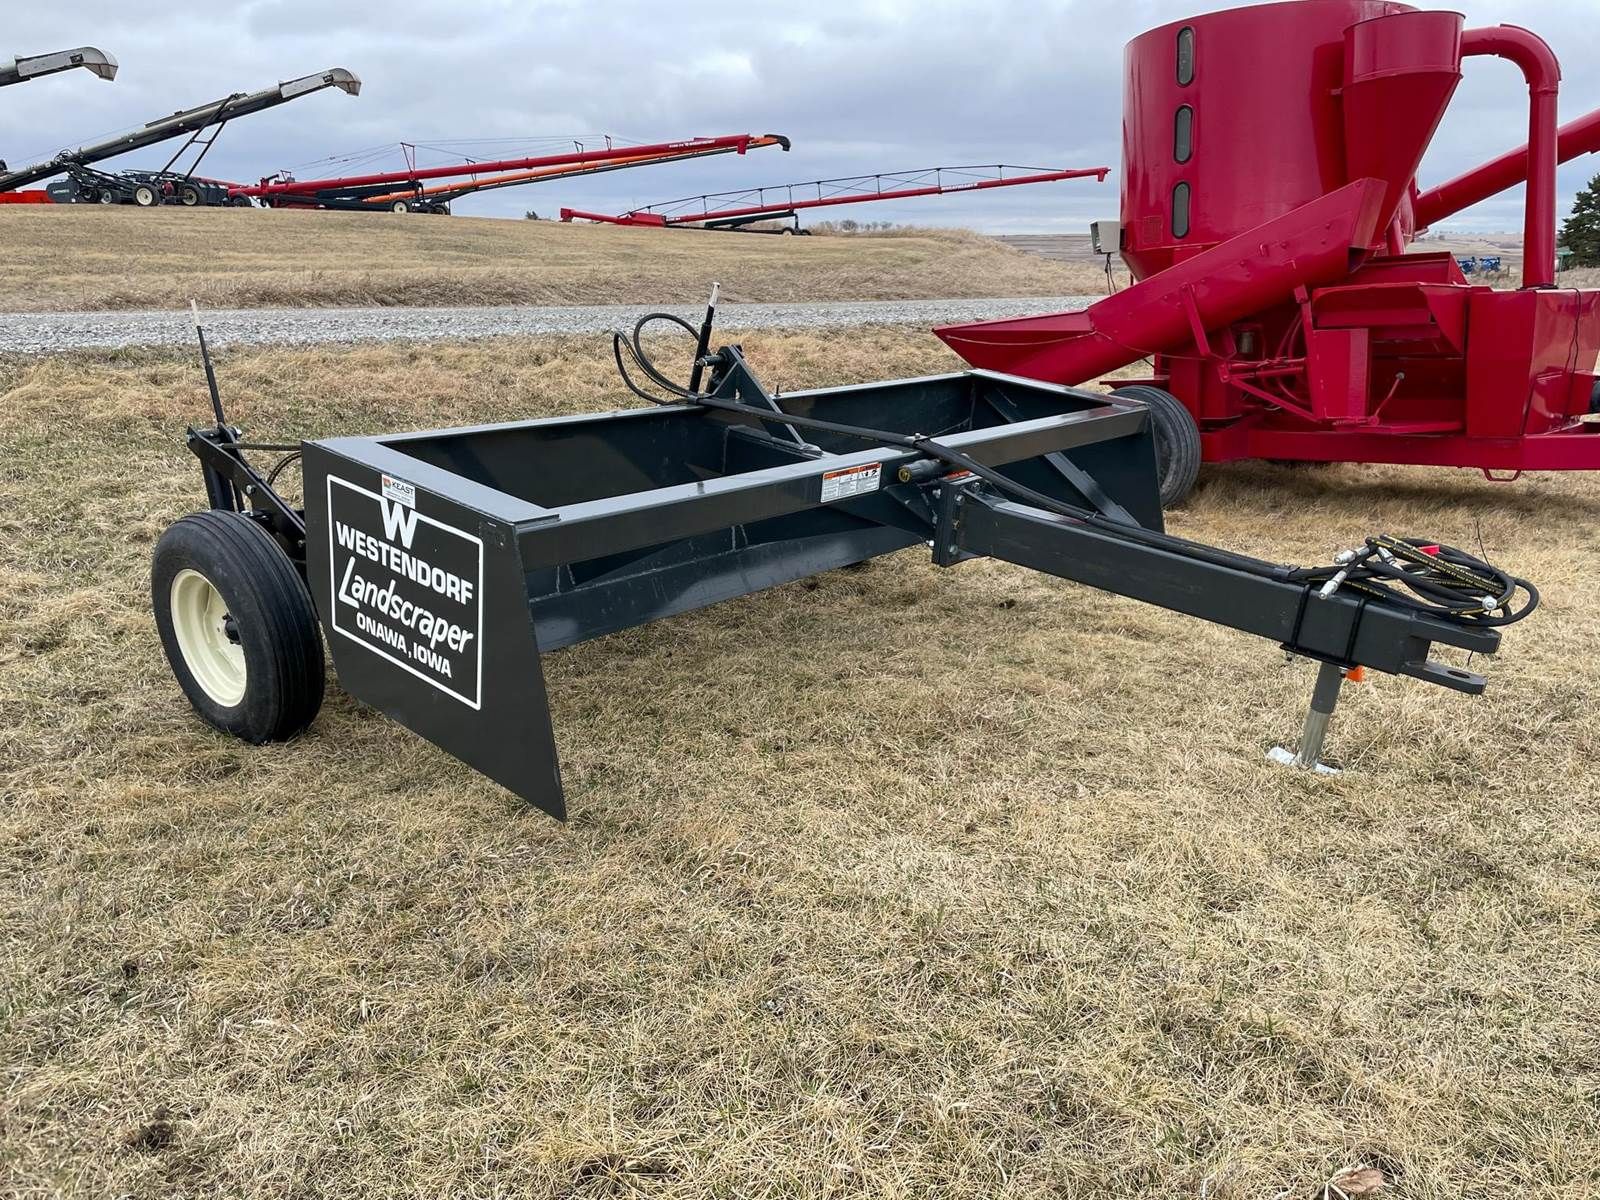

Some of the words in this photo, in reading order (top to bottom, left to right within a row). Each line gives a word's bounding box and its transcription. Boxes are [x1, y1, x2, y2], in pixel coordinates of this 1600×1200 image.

[391, 481, 414, 495] KEAST
[380, 497, 420, 550] W
[335, 520, 474, 606] WESTENDORF
[338, 555, 475, 654] Landscraper
[412, 641, 452, 679] IOWA
